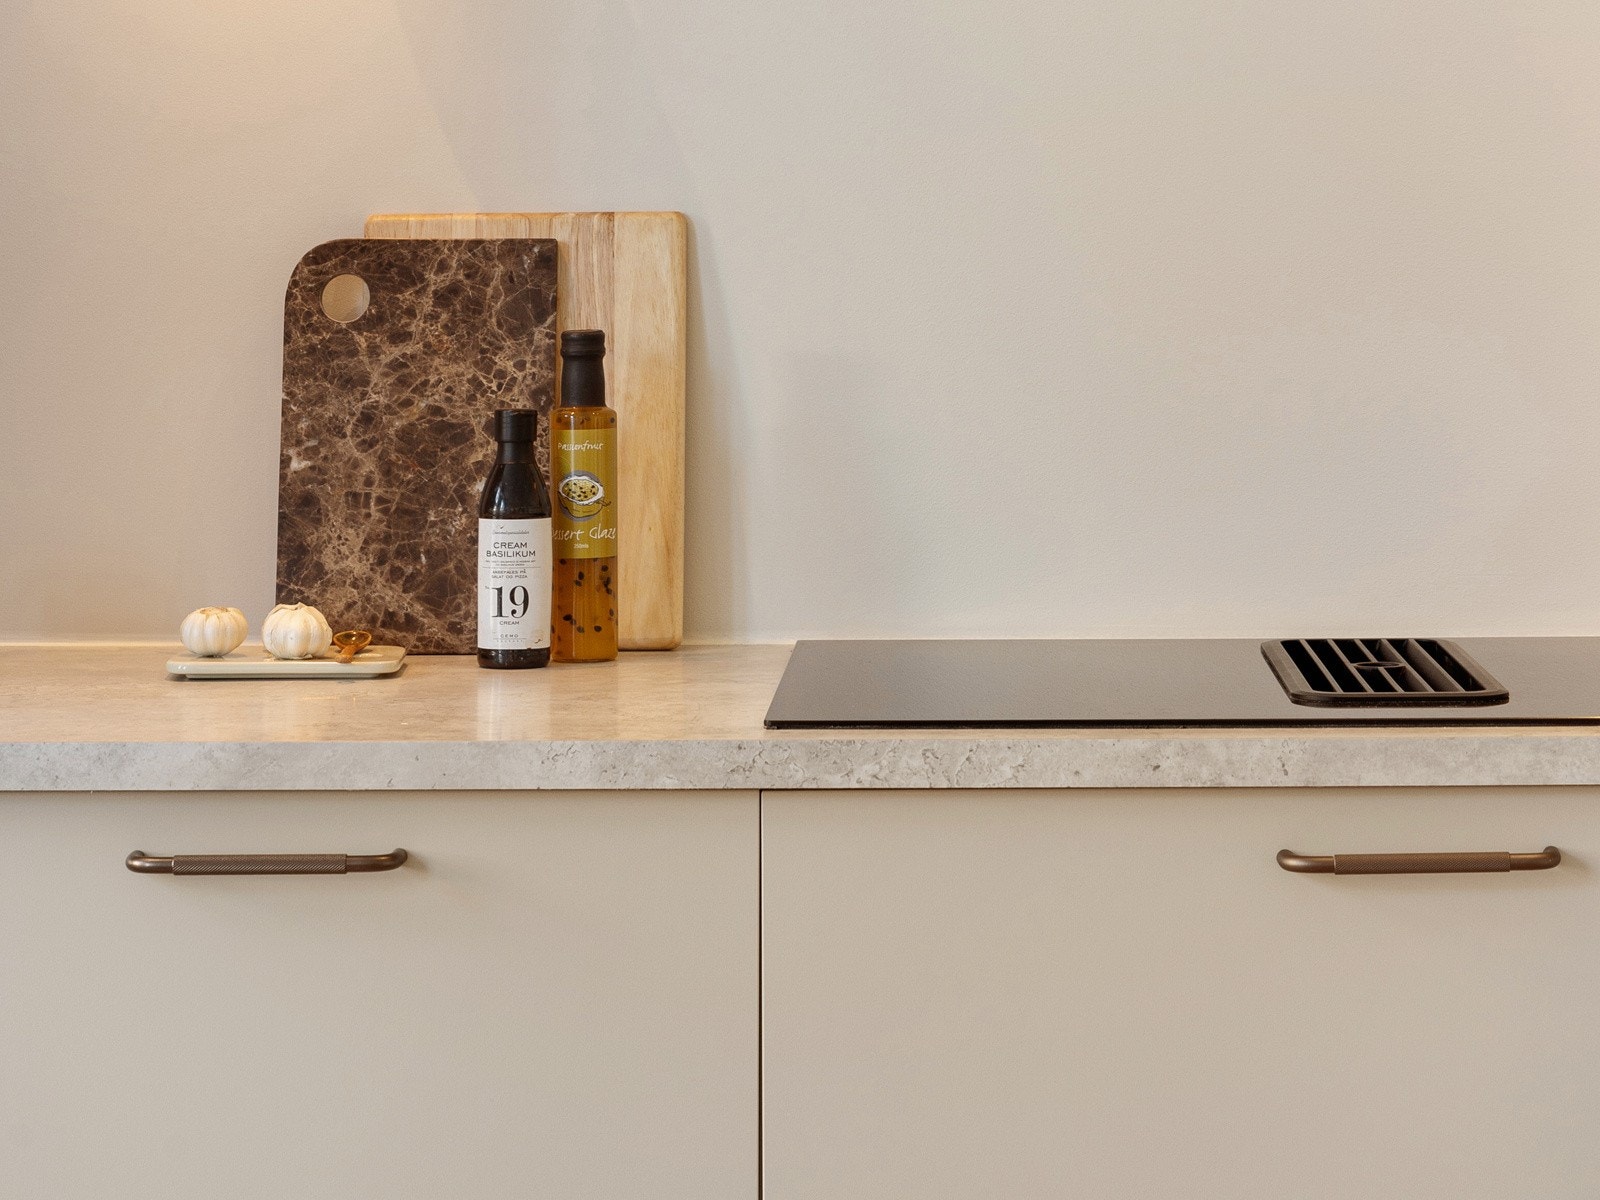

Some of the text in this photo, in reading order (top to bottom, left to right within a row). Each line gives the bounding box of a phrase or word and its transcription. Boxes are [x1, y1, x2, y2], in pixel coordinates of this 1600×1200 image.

[552, 529, 585, 541] essert
[493, 541, 528, 550] CREAM
[486, 550, 536, 558] BASILIKUM
[491, 585, 530, 619] 19
